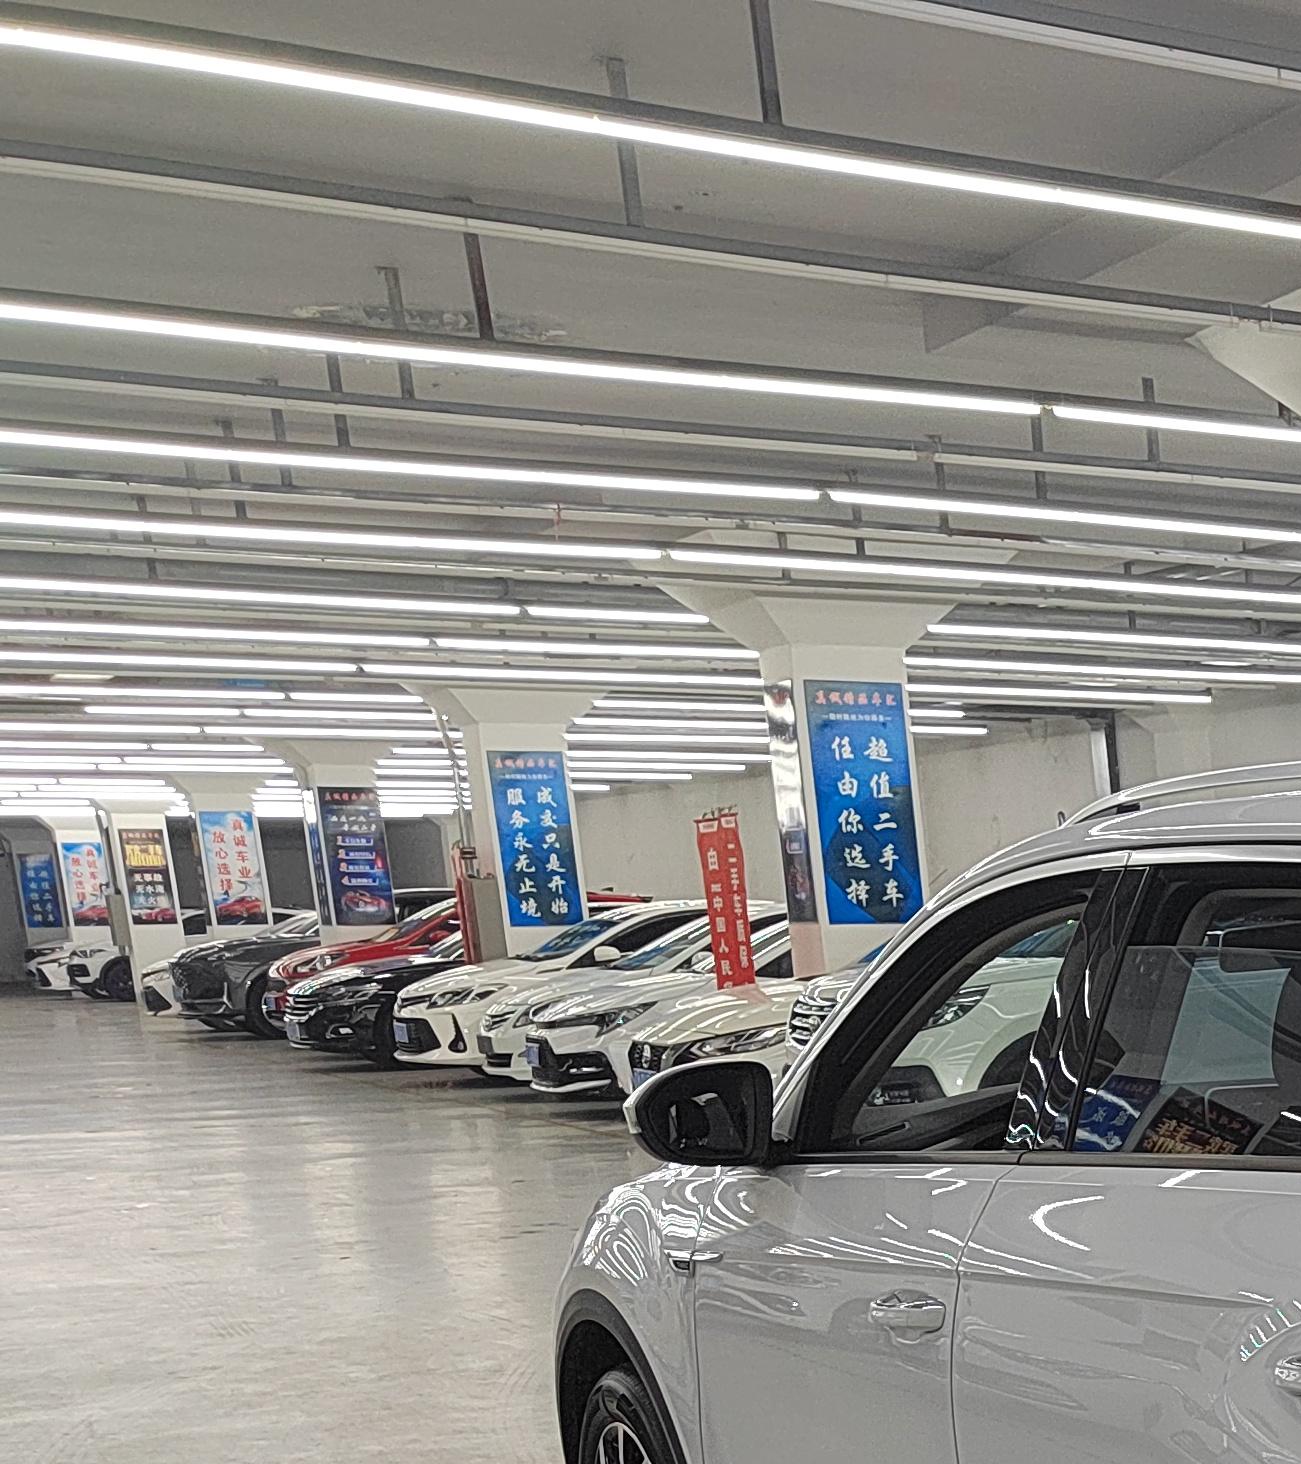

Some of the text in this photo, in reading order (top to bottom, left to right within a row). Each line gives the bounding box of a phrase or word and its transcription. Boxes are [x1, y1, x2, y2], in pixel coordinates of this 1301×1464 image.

[506, 787, 541, 917] 服务永无止境
[536, 786, 569, 914] 成交只是开始
[832, 736, 871, 907] 任由你选择
[864, 737, 904, 907] 超值二手车
